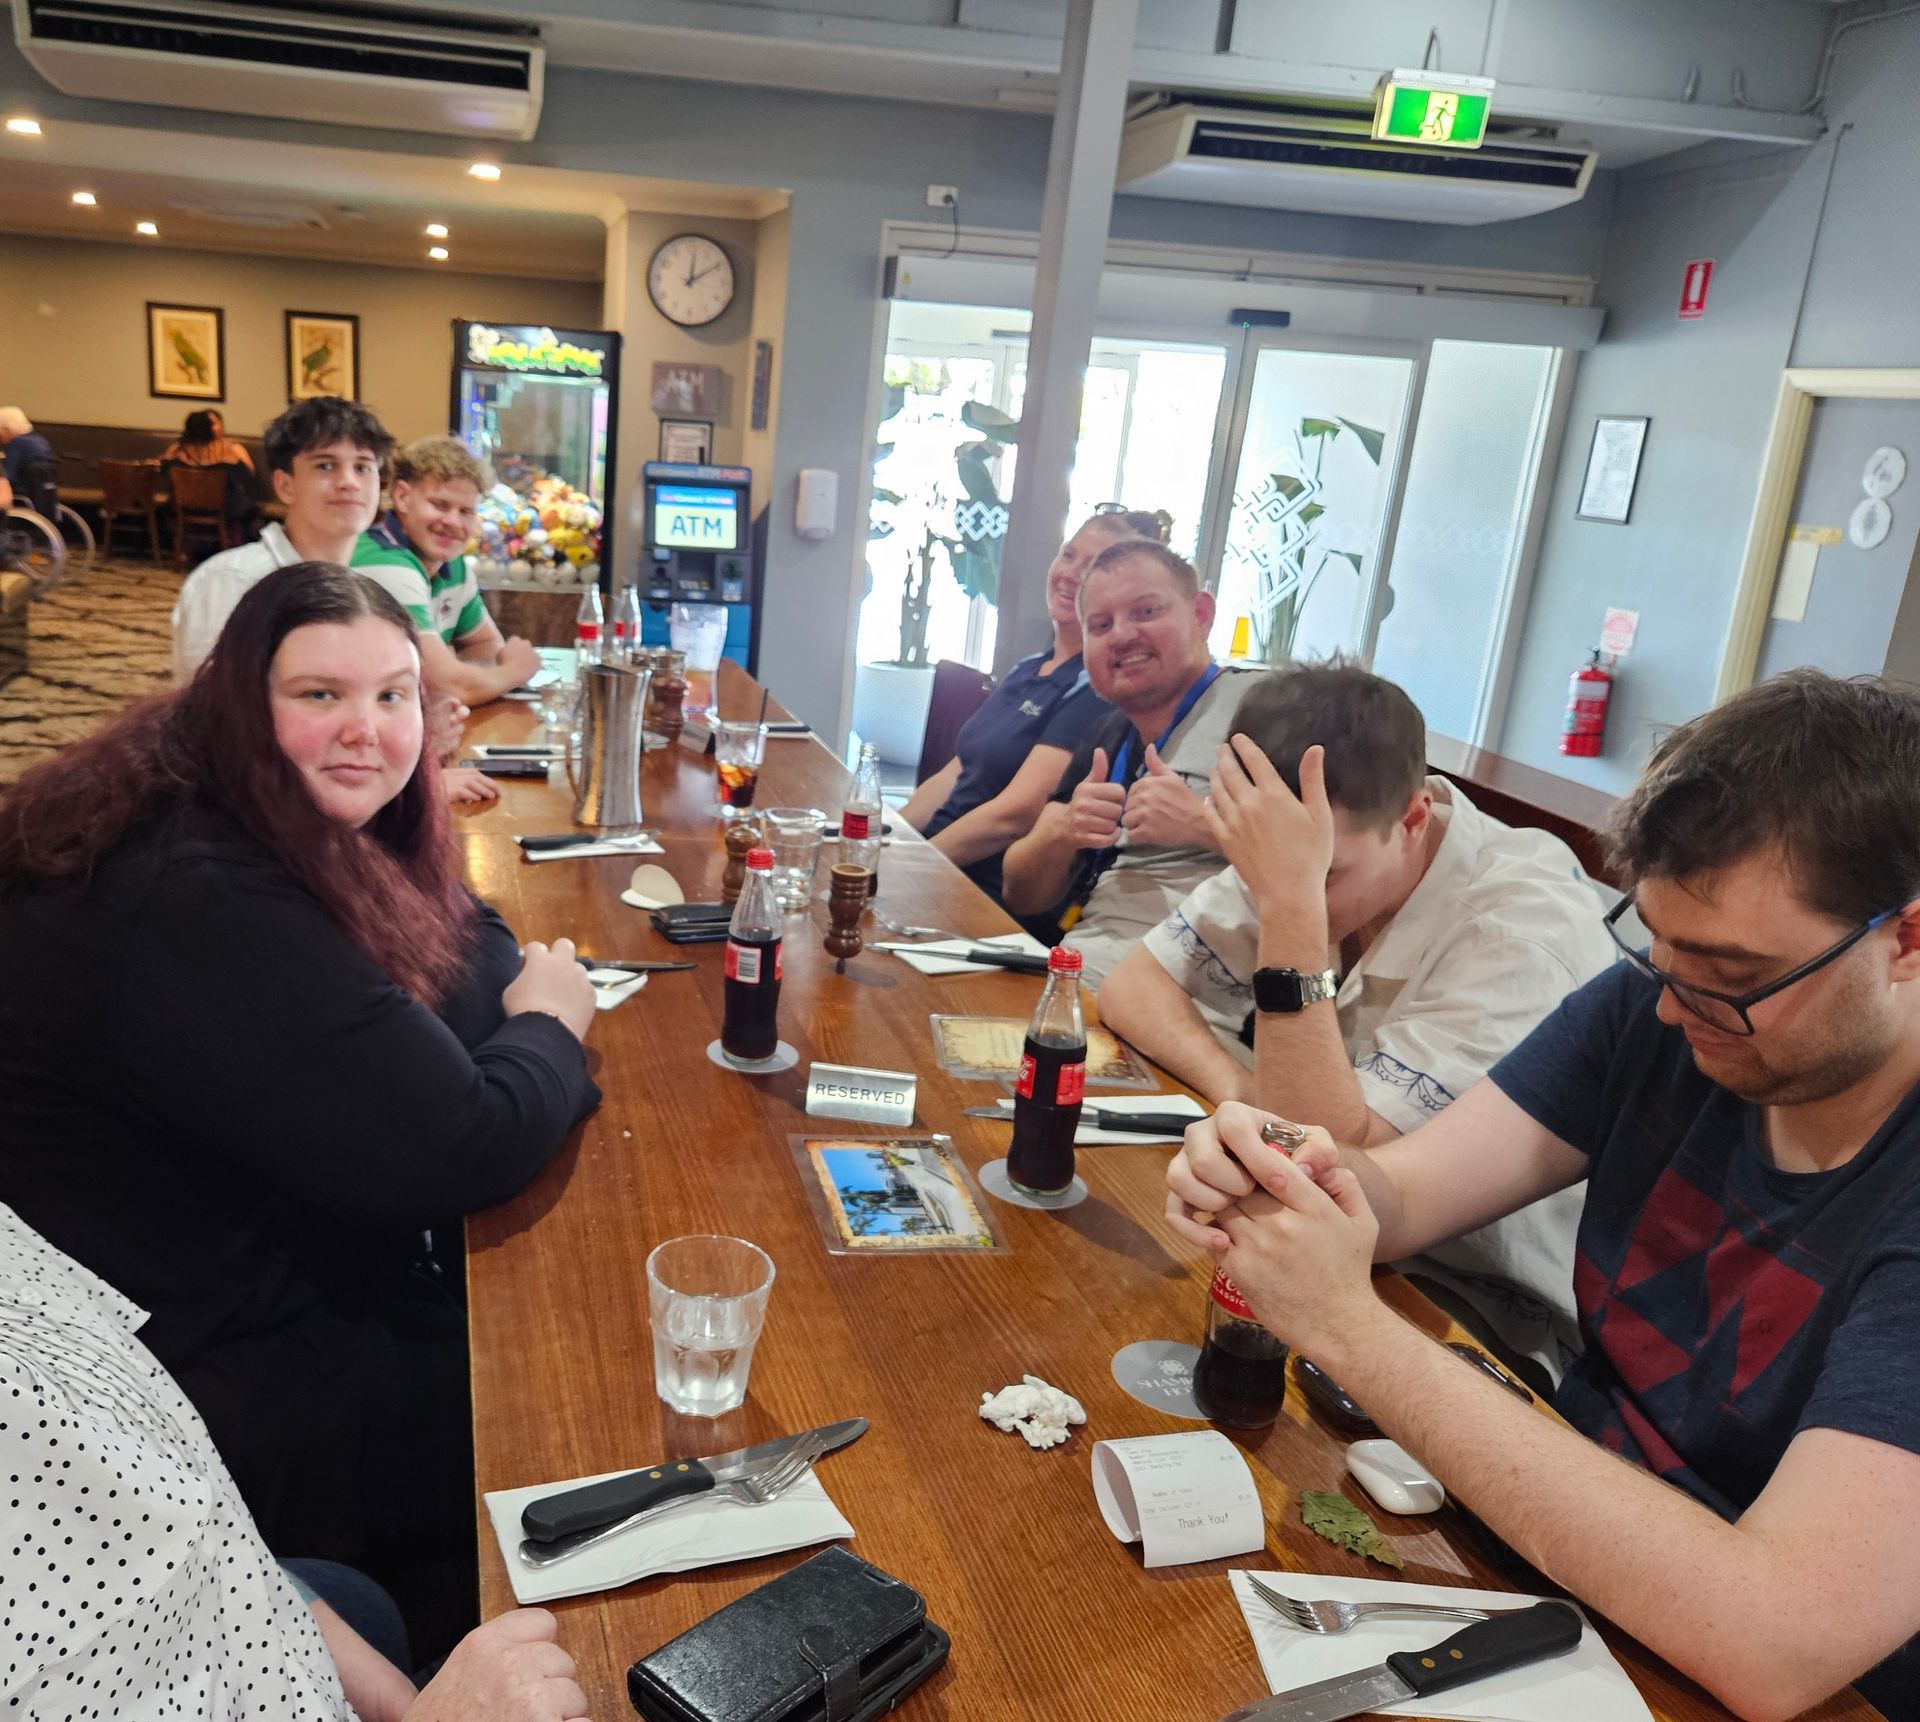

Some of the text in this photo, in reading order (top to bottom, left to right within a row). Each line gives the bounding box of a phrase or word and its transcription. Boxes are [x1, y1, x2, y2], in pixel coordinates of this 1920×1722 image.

[671, 515, 722, 538] ATM
[815, 1083, 905, 1105] RESERVED
[1213, 1281, 1246, 1307] CLASSIC
[1136, 1377, 1193, 1388] SHAM
[1177, 1511, 1229, 1530] Thank You!
